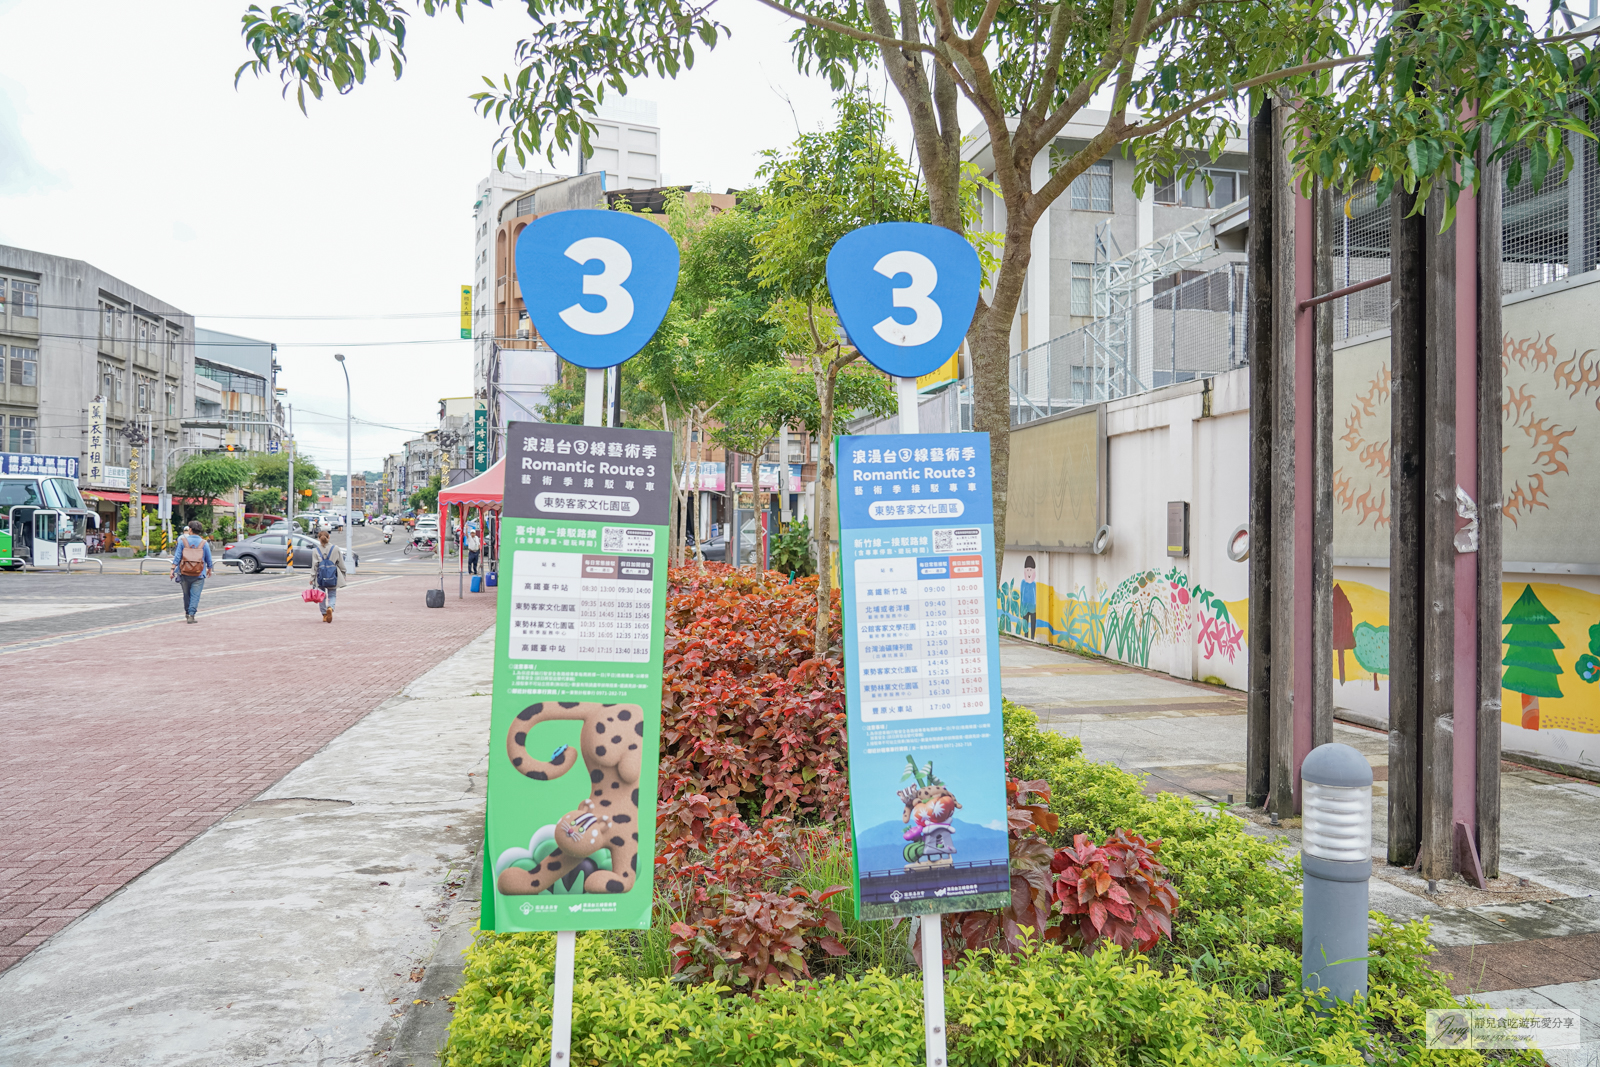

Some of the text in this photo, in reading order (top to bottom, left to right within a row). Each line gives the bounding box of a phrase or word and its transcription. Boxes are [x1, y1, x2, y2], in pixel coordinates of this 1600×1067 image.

[559, 237, 634, 335] 3
[872, 251, 942, 346] 3
[523, 436, 656, 460] 浪漫台3線藝術季
[852, 446, 975, 464] 浪漫台3線藝術季
[522, 457, 655, 477] Romantic Route 3
[853, 466, 975, 481] Romantic Route 3
[544, 497, 631, 512] 東勢客家文化園區
[874, 503, 958, 516] 東勢客家文化園區
